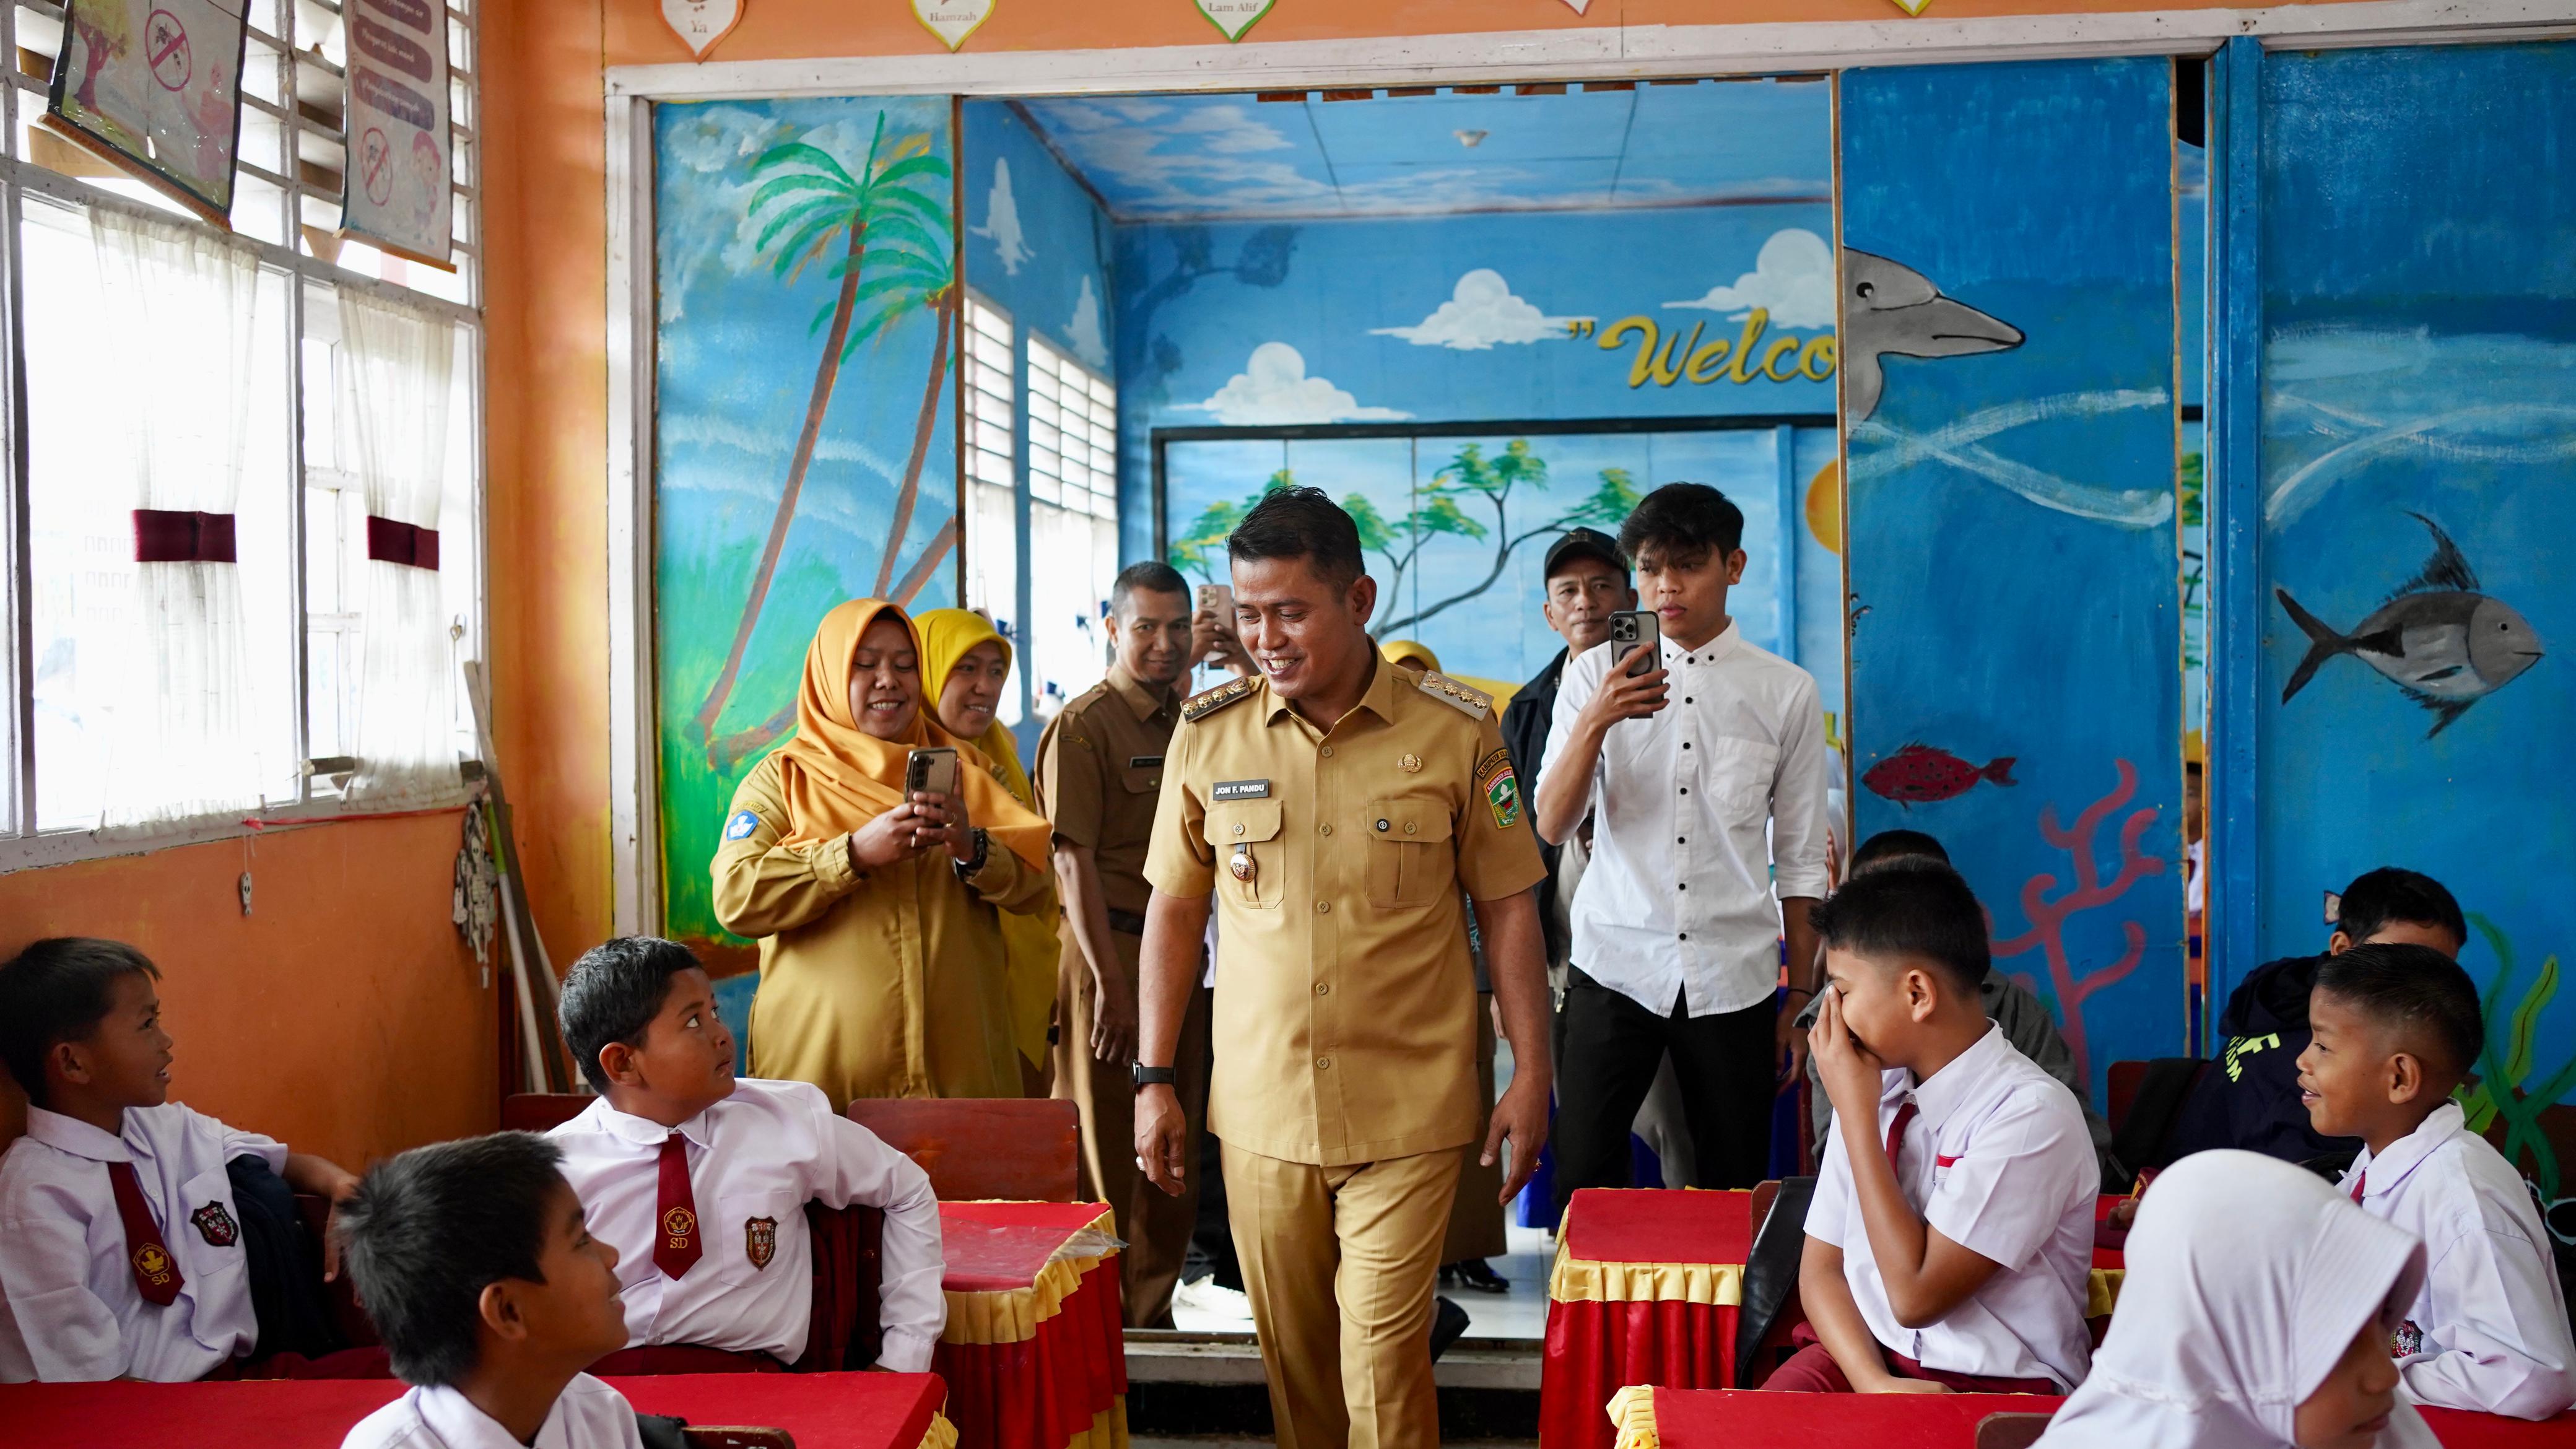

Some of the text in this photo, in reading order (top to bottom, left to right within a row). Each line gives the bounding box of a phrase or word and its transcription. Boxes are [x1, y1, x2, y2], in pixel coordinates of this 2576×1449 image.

[1208, 2, 1258, 12] Lam Alif
[930, 11, 977, 22] Hamzah
[691, 20, 708, 33] Ya
[1215, 784, 1265, 795] JON F. PANDU
[669, 1237, 689, 1249] SD
[152, 1273, 170, 1286] SD
